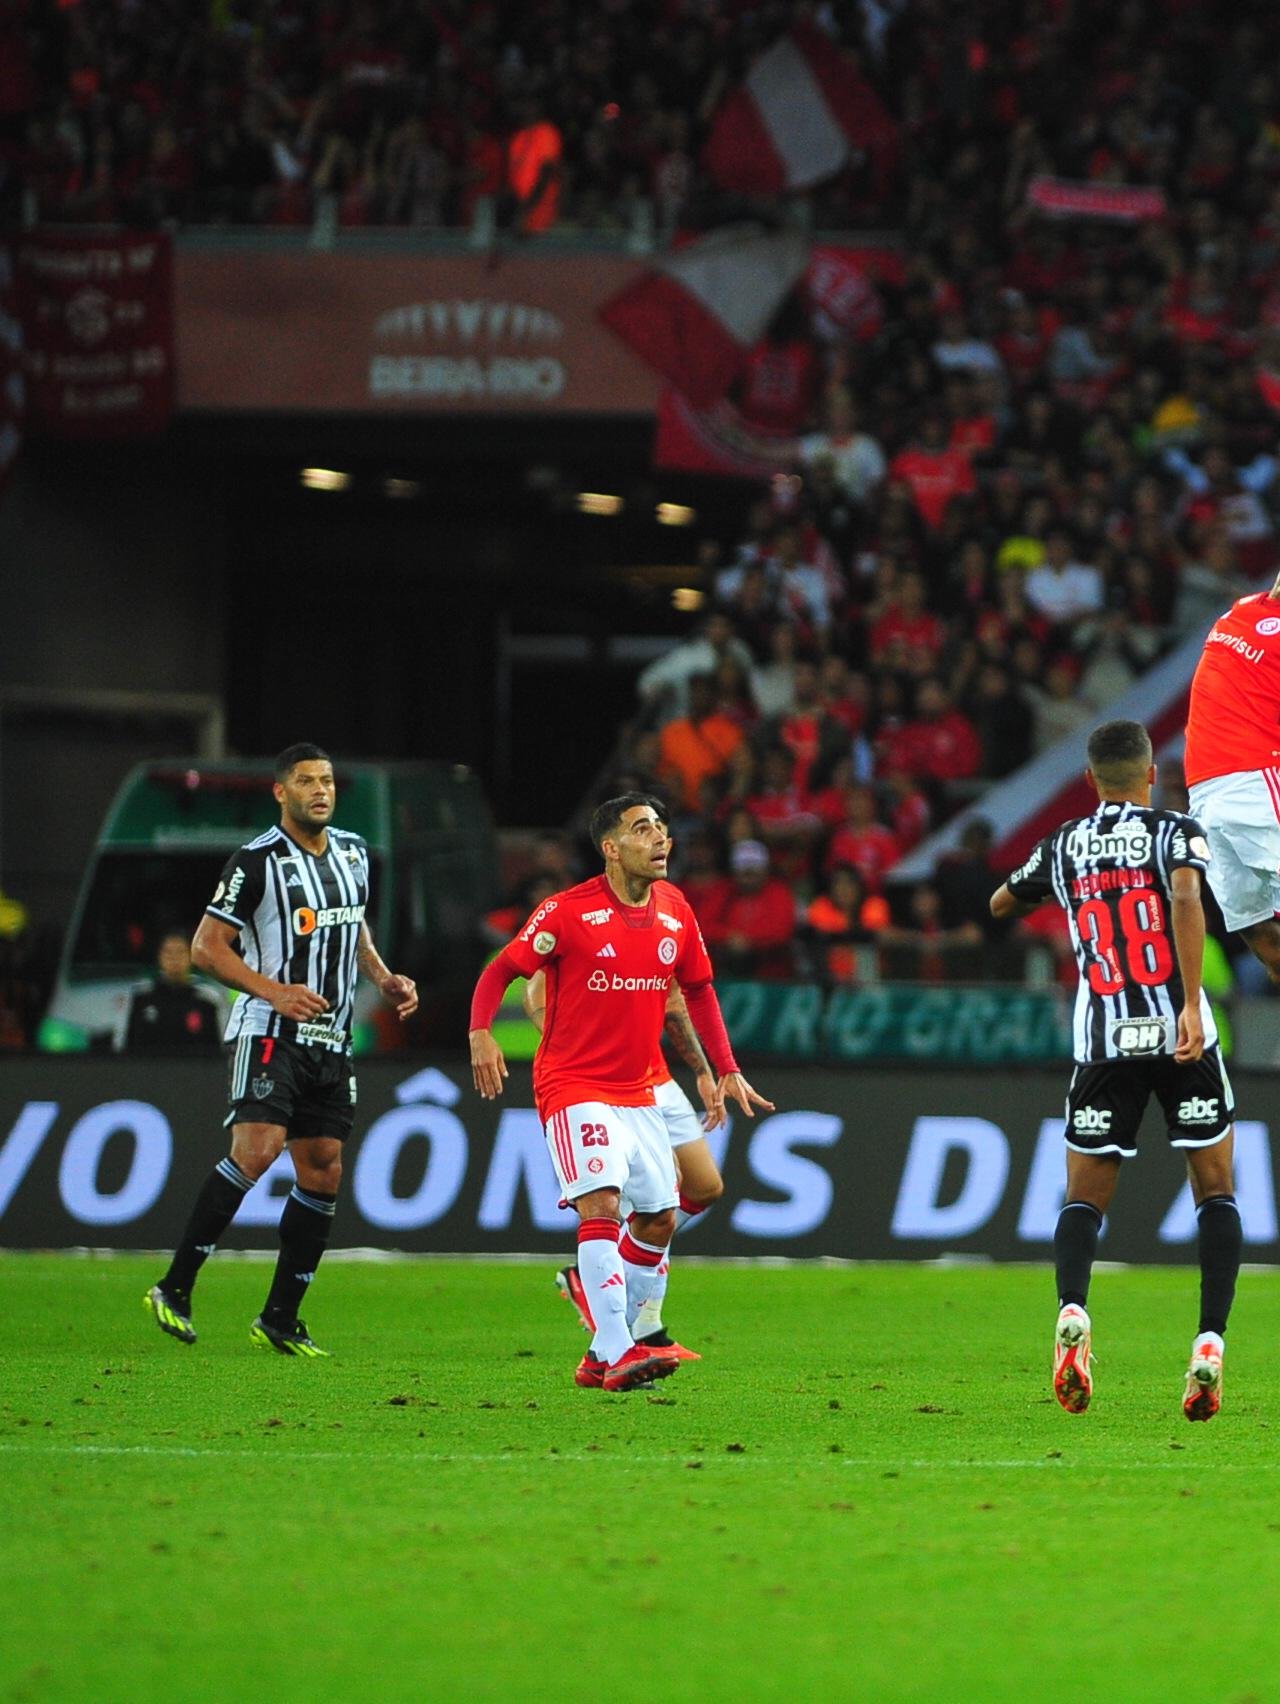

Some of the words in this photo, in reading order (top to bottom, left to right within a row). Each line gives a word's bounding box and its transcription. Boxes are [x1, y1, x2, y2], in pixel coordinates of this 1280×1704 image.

[1087, 834, 1147, 861] bmg
[229, 866, 246, 903] MRV
[316, 905, 366, 928] BETAN
[520, 909, 546, 942] vero
[1077, 888, 1174, 996] 38
[1119, 1025, 1160, 1049] BH
[260, 1037, 276, 1065] 7
[1074, 1105, 1112, 1130] abc
[1178, 1096, 1219, 1120] abc
[580, 1123, 610, 1148] 23
